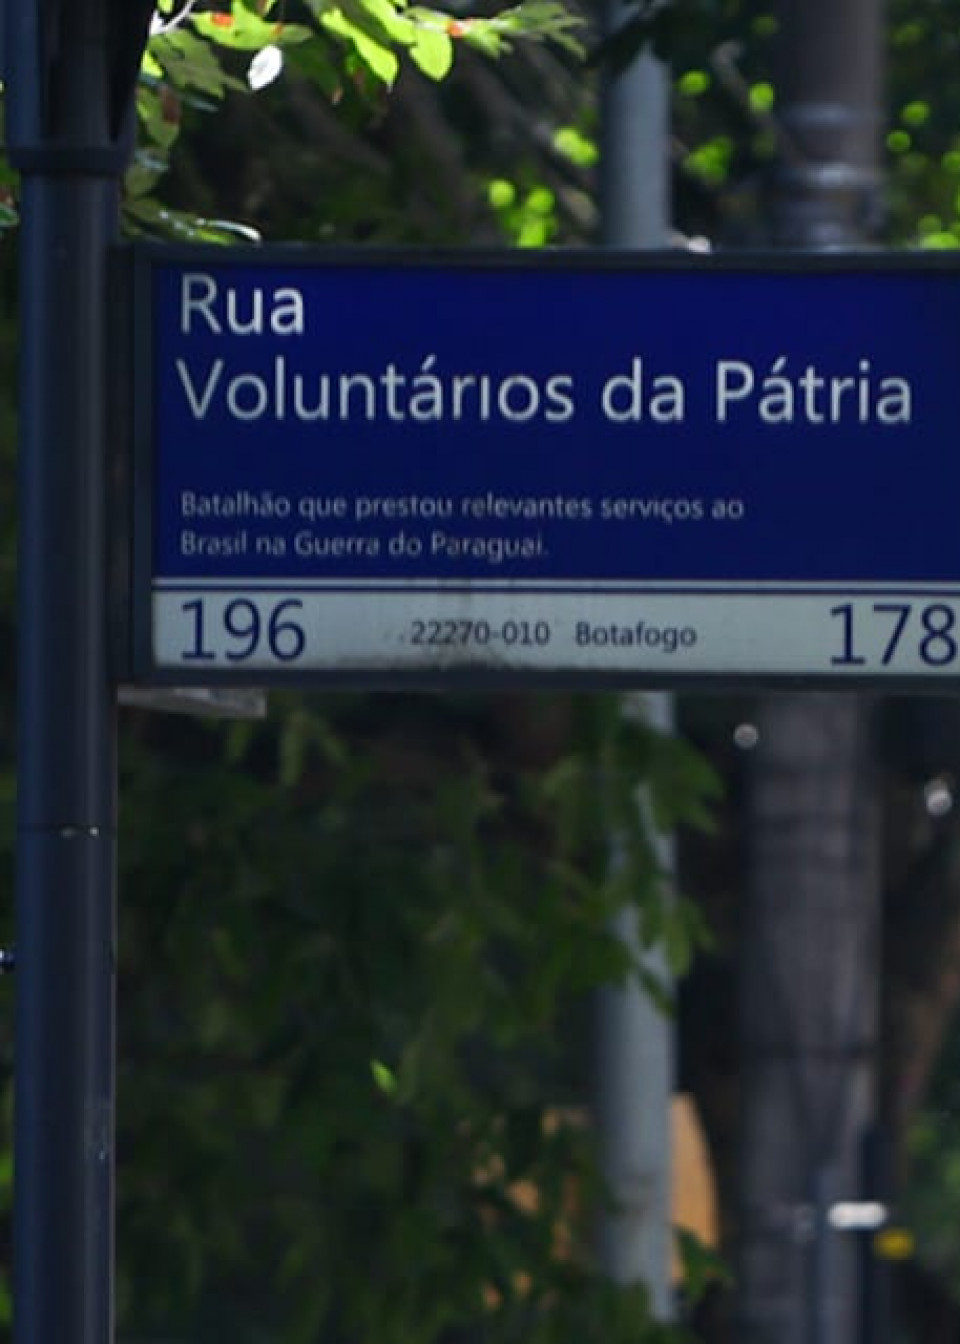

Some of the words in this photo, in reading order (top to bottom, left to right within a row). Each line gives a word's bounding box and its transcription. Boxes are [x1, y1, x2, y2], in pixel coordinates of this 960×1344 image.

[180, 272, 304, 335] Rua
[176, 354, 575, 421] Voluntários
[601, 356, 685, 423] da
[716, 356, 912, 423] Pátria
[181, 491, 291, 518] Batalhão
[299, 496, 348, 521] que
[356, 496, 452, 521] prestou
[461, 491, 592, 519] relevantes
[601, 497, 703, 524] serviços
[711, 498, 745, 519] ao
[181, 530, 248, 556] Brasil
[256, 536, 287, 556] na
[295, 532, 380, 556] Guerra
[388, 530, 423, 556] do
[180, 598, 307, 662] 196
[411, 620, 551, 645] 22270-010
[575, 620, 698, 652] Botafogo
[829, 603, 958, 666] 178
